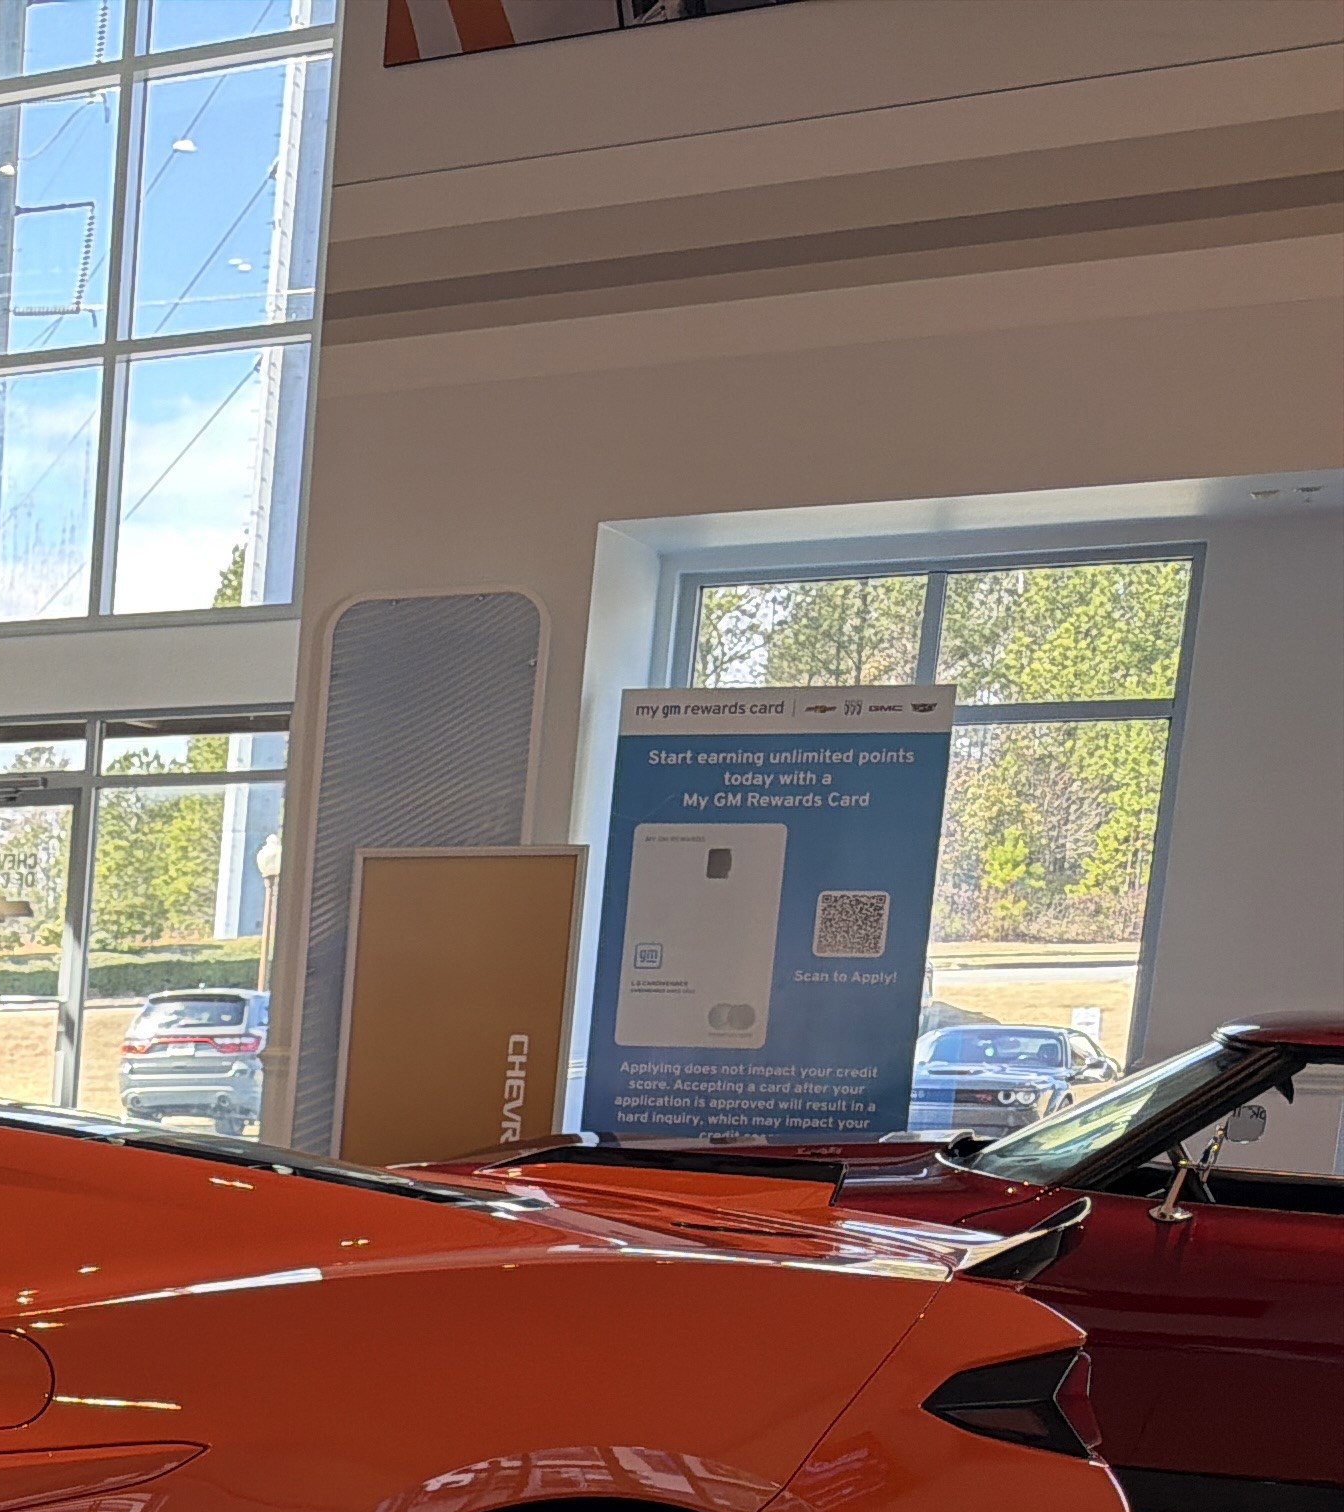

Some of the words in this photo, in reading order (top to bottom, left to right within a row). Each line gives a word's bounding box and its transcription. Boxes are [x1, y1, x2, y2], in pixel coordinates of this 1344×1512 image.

[635, 703, 659, 718] my
[662, 703, 681, 718] gm
[684, 701, 746, 716] rewards
[749, 700, 785, 716] card
[648, 749, 693, 765] Start
[697, 750, 764, 767] earning
[769, 749, 853, 764] unlimited
[857, 748, 915, 767] points
[723, 771, 774, 789] today
[779, 770, 817, 786] with
[821, 774, 833, 785] a
[683, 792, 709, 811] My
[713, 792, 741, 807] GM
[746, 792, 823, 808] Rewards
[827, 792, 870, 807] Card
[794, 970, 829, 982] Scan
[833, 970, 848, 983] to
[850, 971, 898, 985] Apply!
[620, 1061, 681, 1077] Applying
[684, 1062, 717, 1076] does
[721, 1063, 744, 1077] not
[748, 1064, 795, 1080] impact
[800, 1067, 833, 1081] your
[836, 1066, 878, 1080] credit
[499, 1034, 529, 1144] CHEVR
[628, 1080, 670, 1091] score.
[673, 1079, 743, 1095] Accepting
[747, 1082, 756, 1092] a
[759, 1081, 791, 1094] card
[794, 1081, 828, 1095] after
[832, 1084, 865, 1098] your
[614, 1095, 691, 1111] application
[694, 1096, 706, 1108] is
[709, 1097, 774, 1114] approved
[778, 1098, 803, 1111] will
[806, 1099, 846, 1113] result
[850, 1100, 865, 1112] in
[867, 1103, 876, 1113] a
[616, 1111, 649, 1125] hard
[708, 1113, 748, 1127] which
[752, 1116, 781, 1130] may
[785, 1115, 834, 1131] impact
[837, 1118, 872, 1132] your
